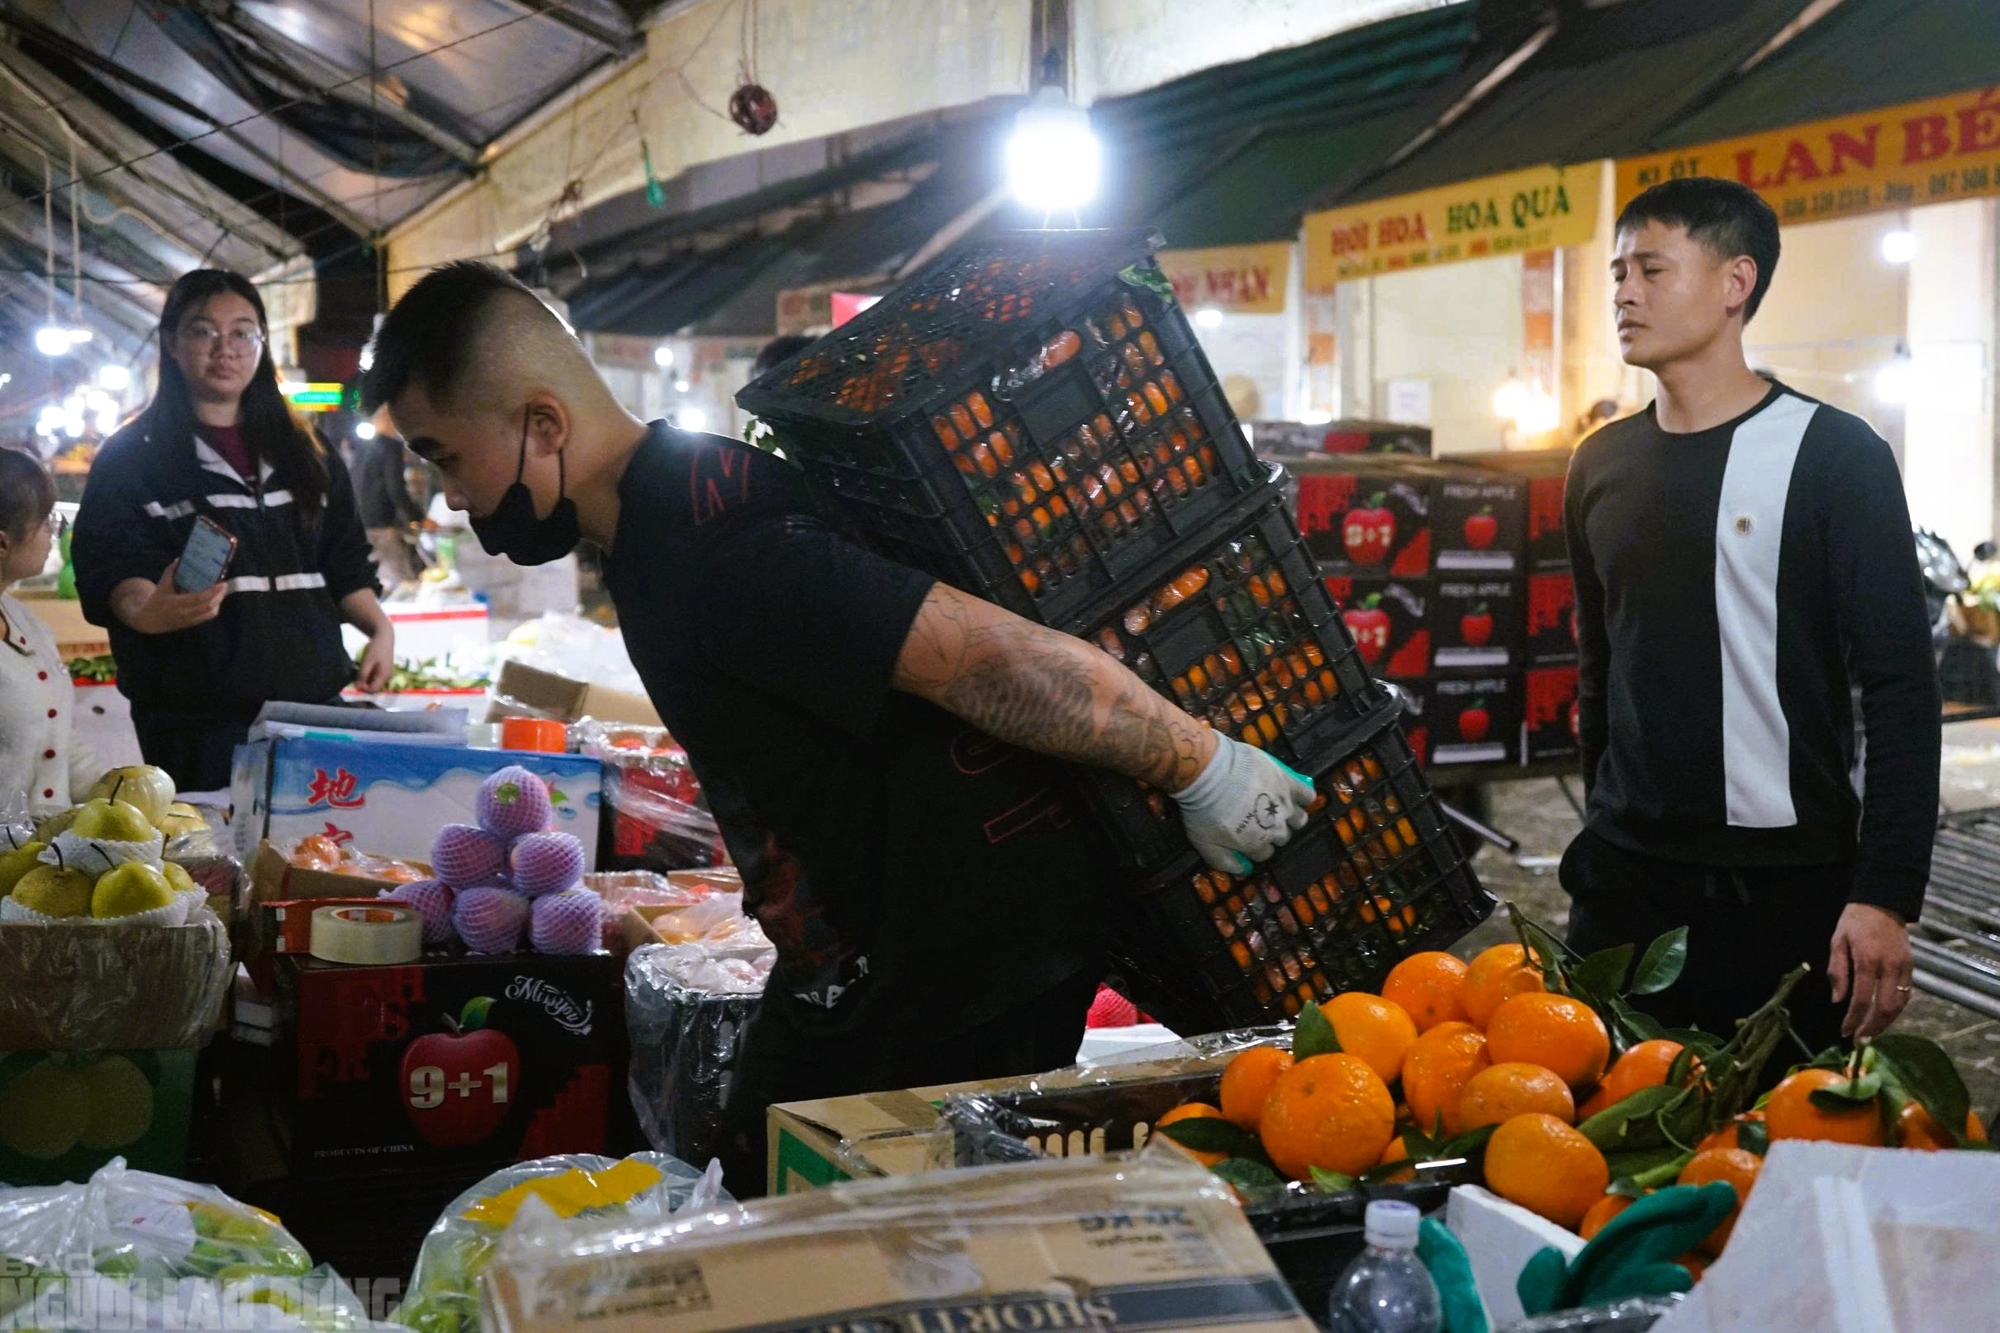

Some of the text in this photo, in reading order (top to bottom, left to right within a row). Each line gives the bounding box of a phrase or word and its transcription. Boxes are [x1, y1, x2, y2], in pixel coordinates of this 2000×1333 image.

[1733, 123, 1882, 191] LAN
[1445, 198, 1499, 234] HOA
[306, 766, 366, 809] 地
[409, 1061, 508, 1110] 9+1
[313, 1144, 415, 1158] PRODUCTS OF CHINA
